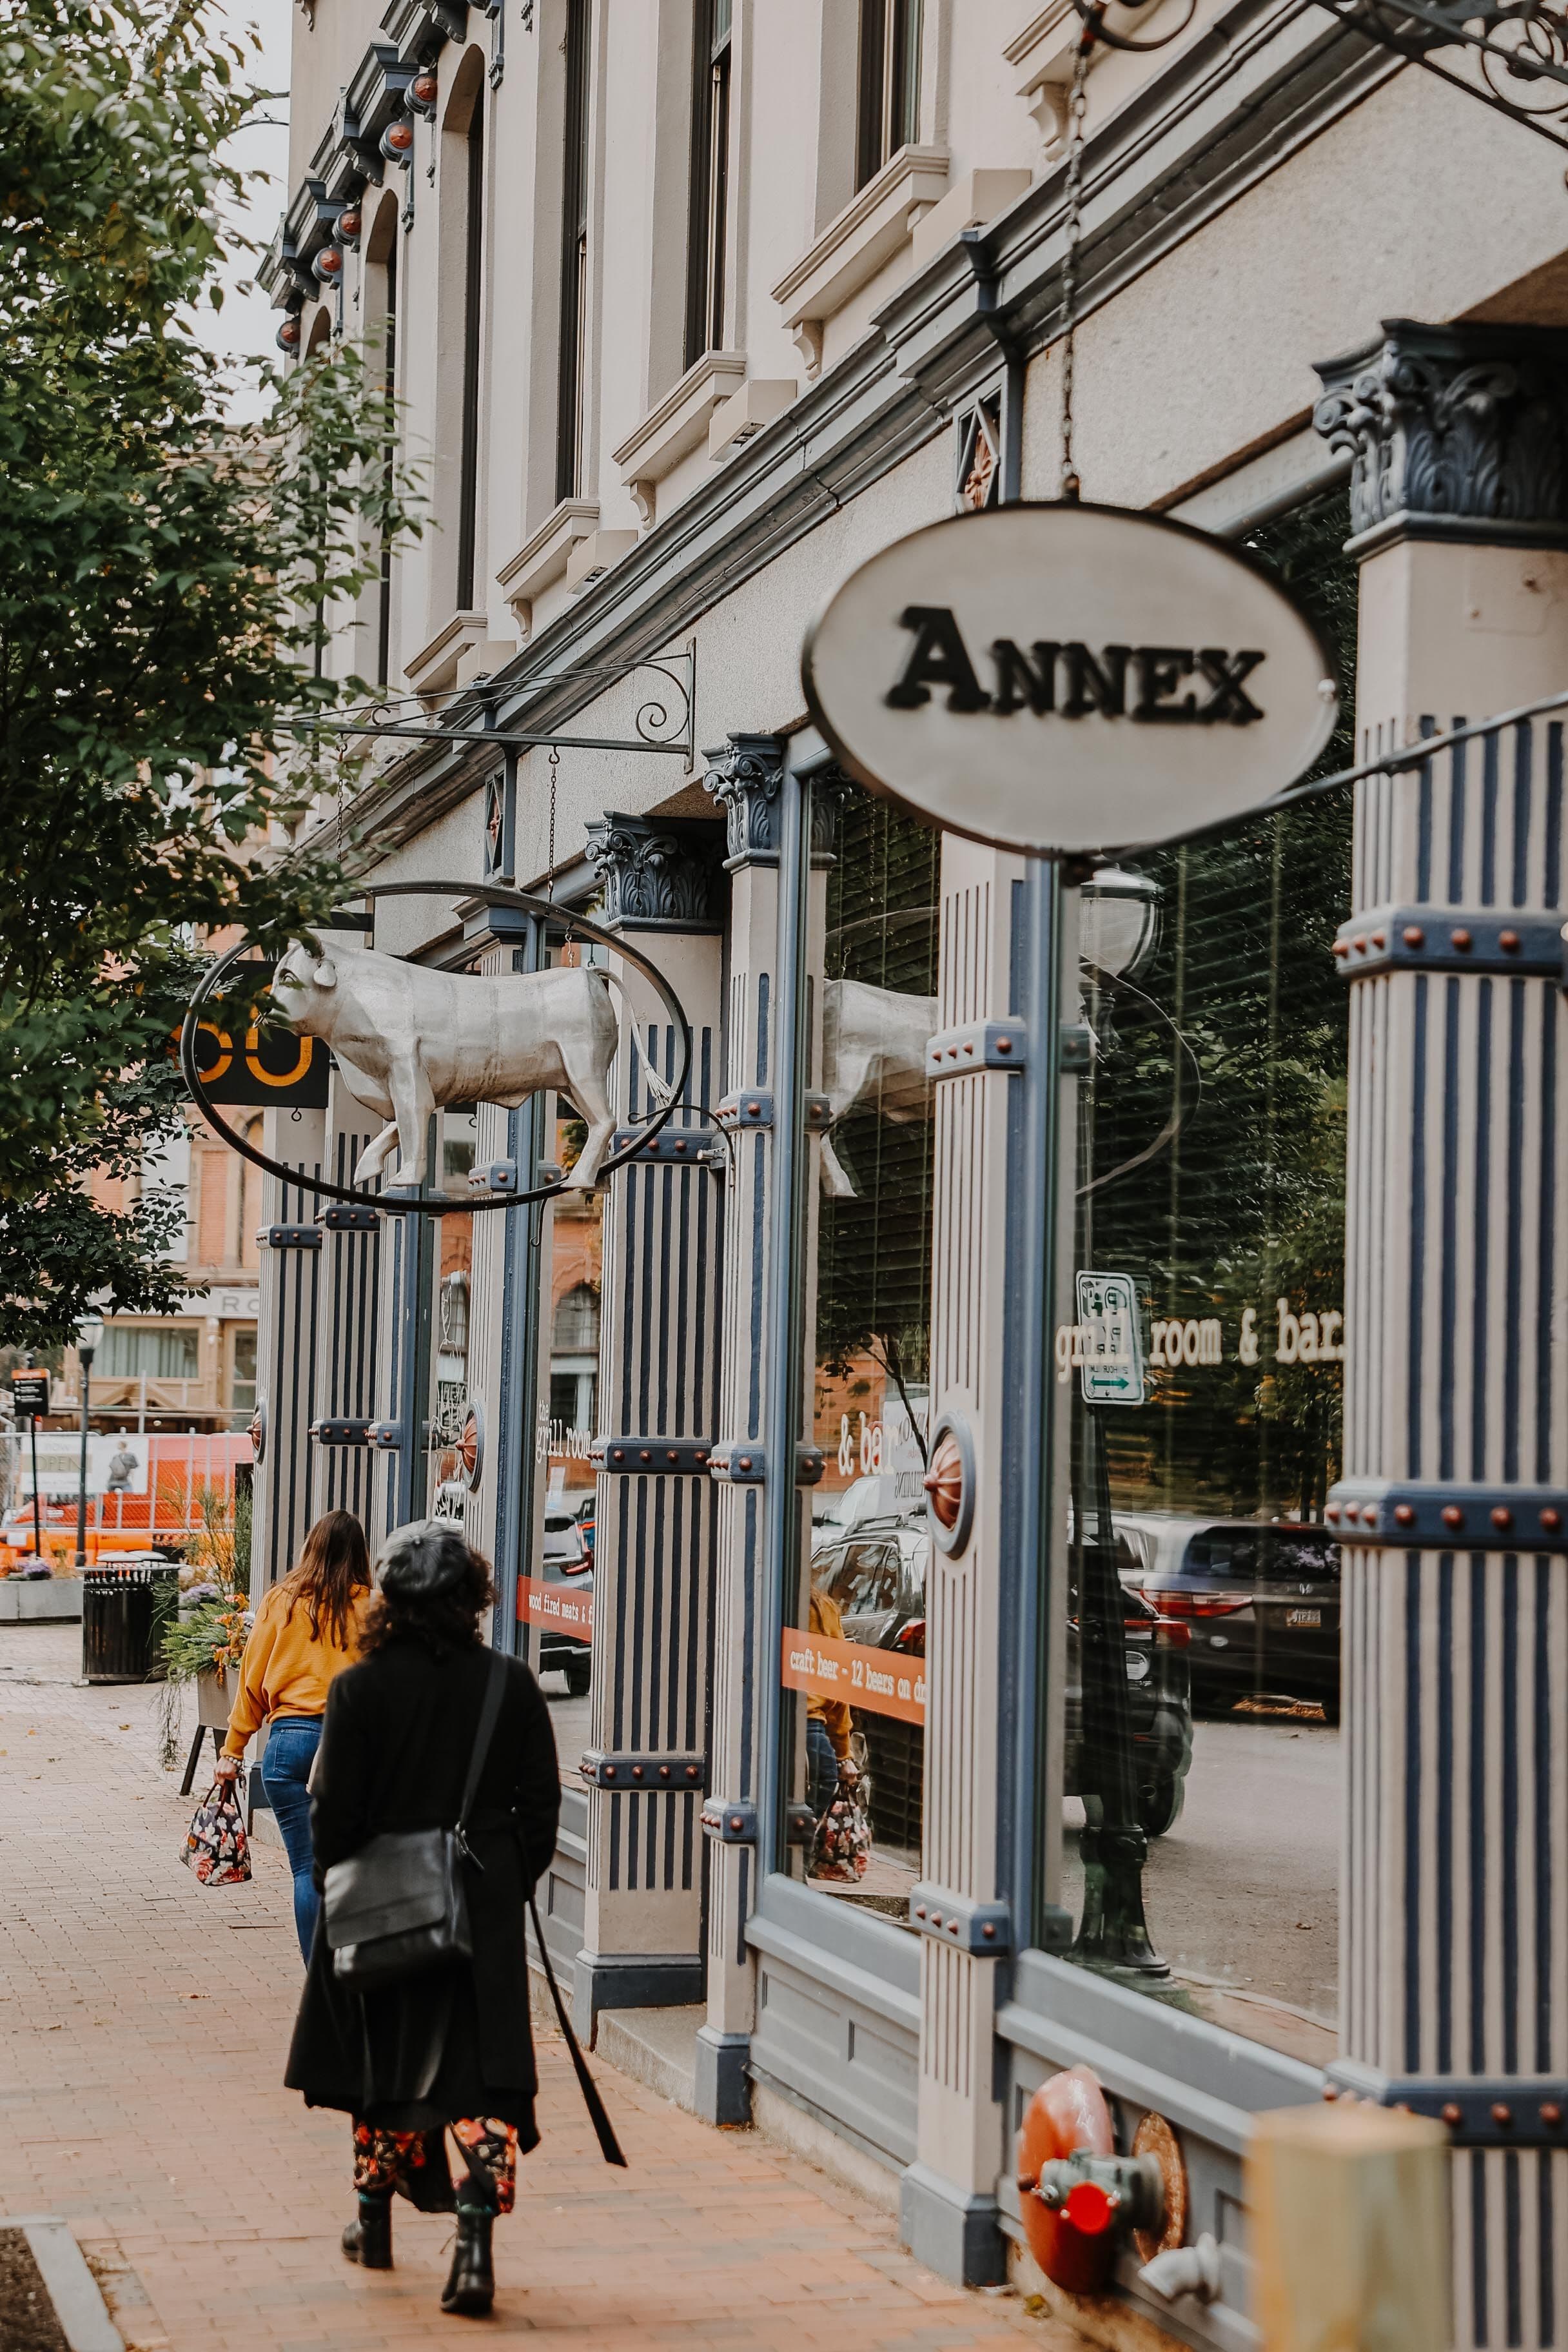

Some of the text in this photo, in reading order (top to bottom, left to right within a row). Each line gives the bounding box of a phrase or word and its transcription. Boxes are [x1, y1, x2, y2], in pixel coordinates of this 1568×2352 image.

[885, 605, 1266, 725] ANNEX
[1055, 1308, 1129, 1383] grill
[1149, 1318, 1222, 1367] room
[1239, 1308, 1258, 1366] &
[539, 1400, 549, 1421] the
[34, 1455, 84, 1471] OPEN
[536, 1419, 591, 1464] grill room
[838, 1413, 855, 1476] &
[859, 1411, 896, 1476] bar
[529, 1592, 542, 1611] wood
[544, 1593, 560, 1616] fired
[562, 1602, 579, 1622] meats
[582, 1605, 585, 1623] &
[790, 1648, 815, 1674] craft
[817, 1651, 838, 1680] beer
[851, 1660, 864, 1687] 12
[865, 1663, 895, 1696] beers
[897, 1677, 912, 1700] on
